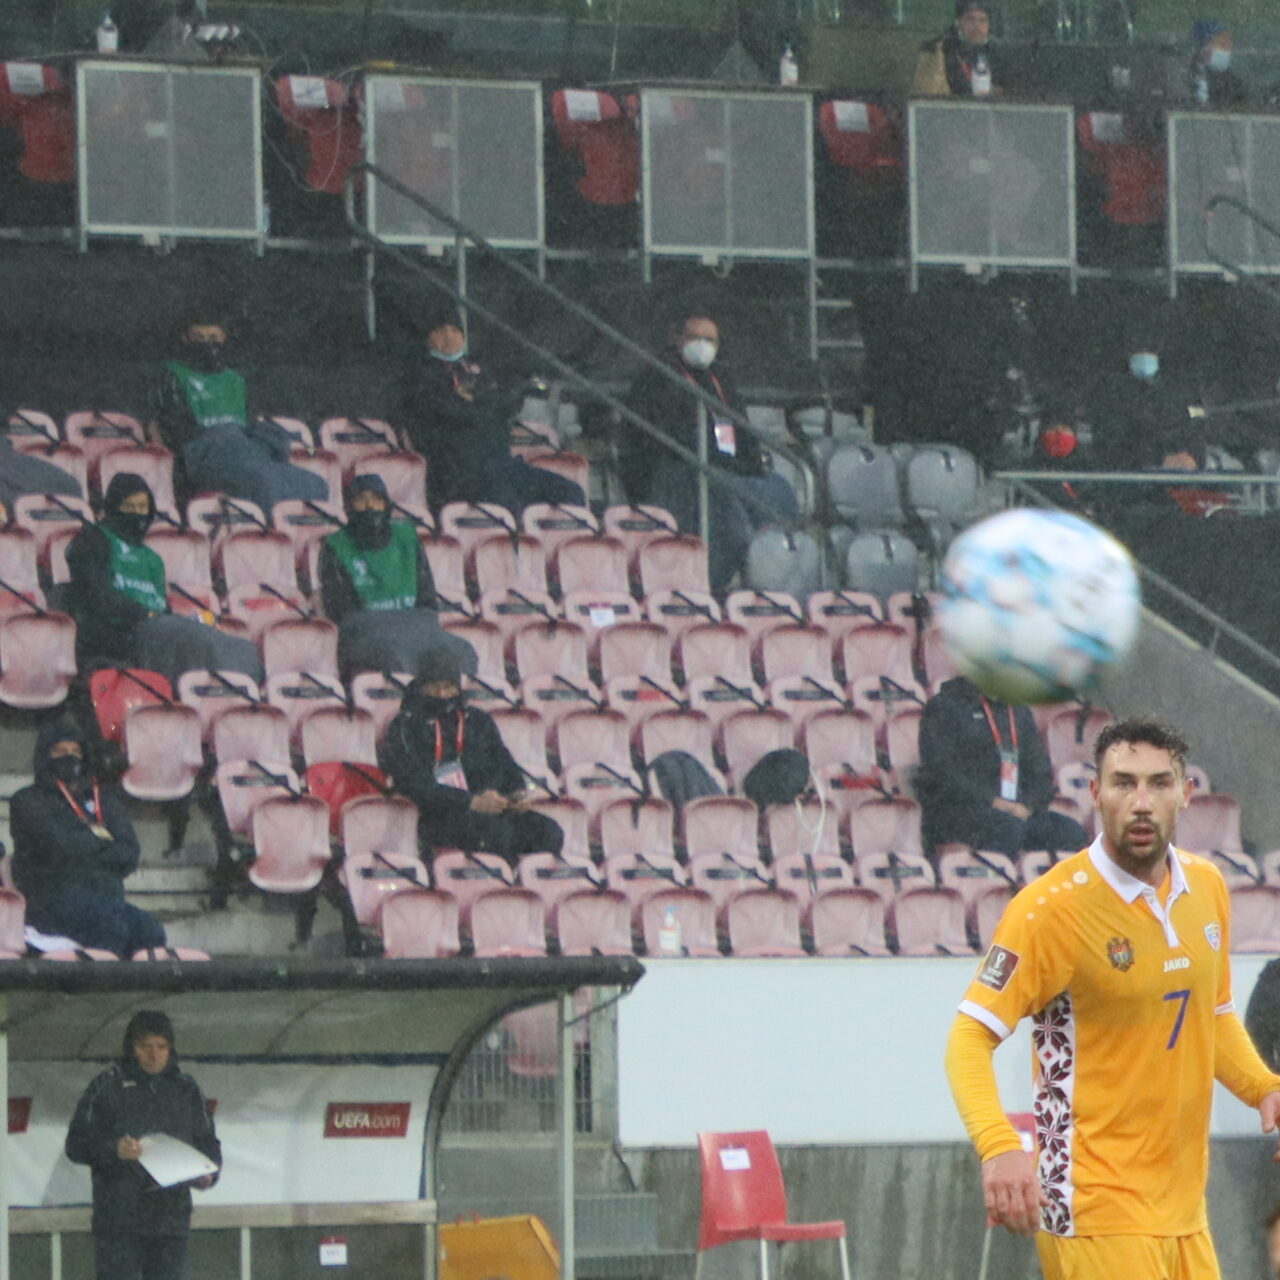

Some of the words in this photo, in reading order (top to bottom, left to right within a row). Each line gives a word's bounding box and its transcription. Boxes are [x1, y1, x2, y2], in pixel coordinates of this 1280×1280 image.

[1163, 957, 1191, 973] JAKO
[1163, 989, 1191, 1050] 7
[334, 1112, 402, 1130] UEFA.com
